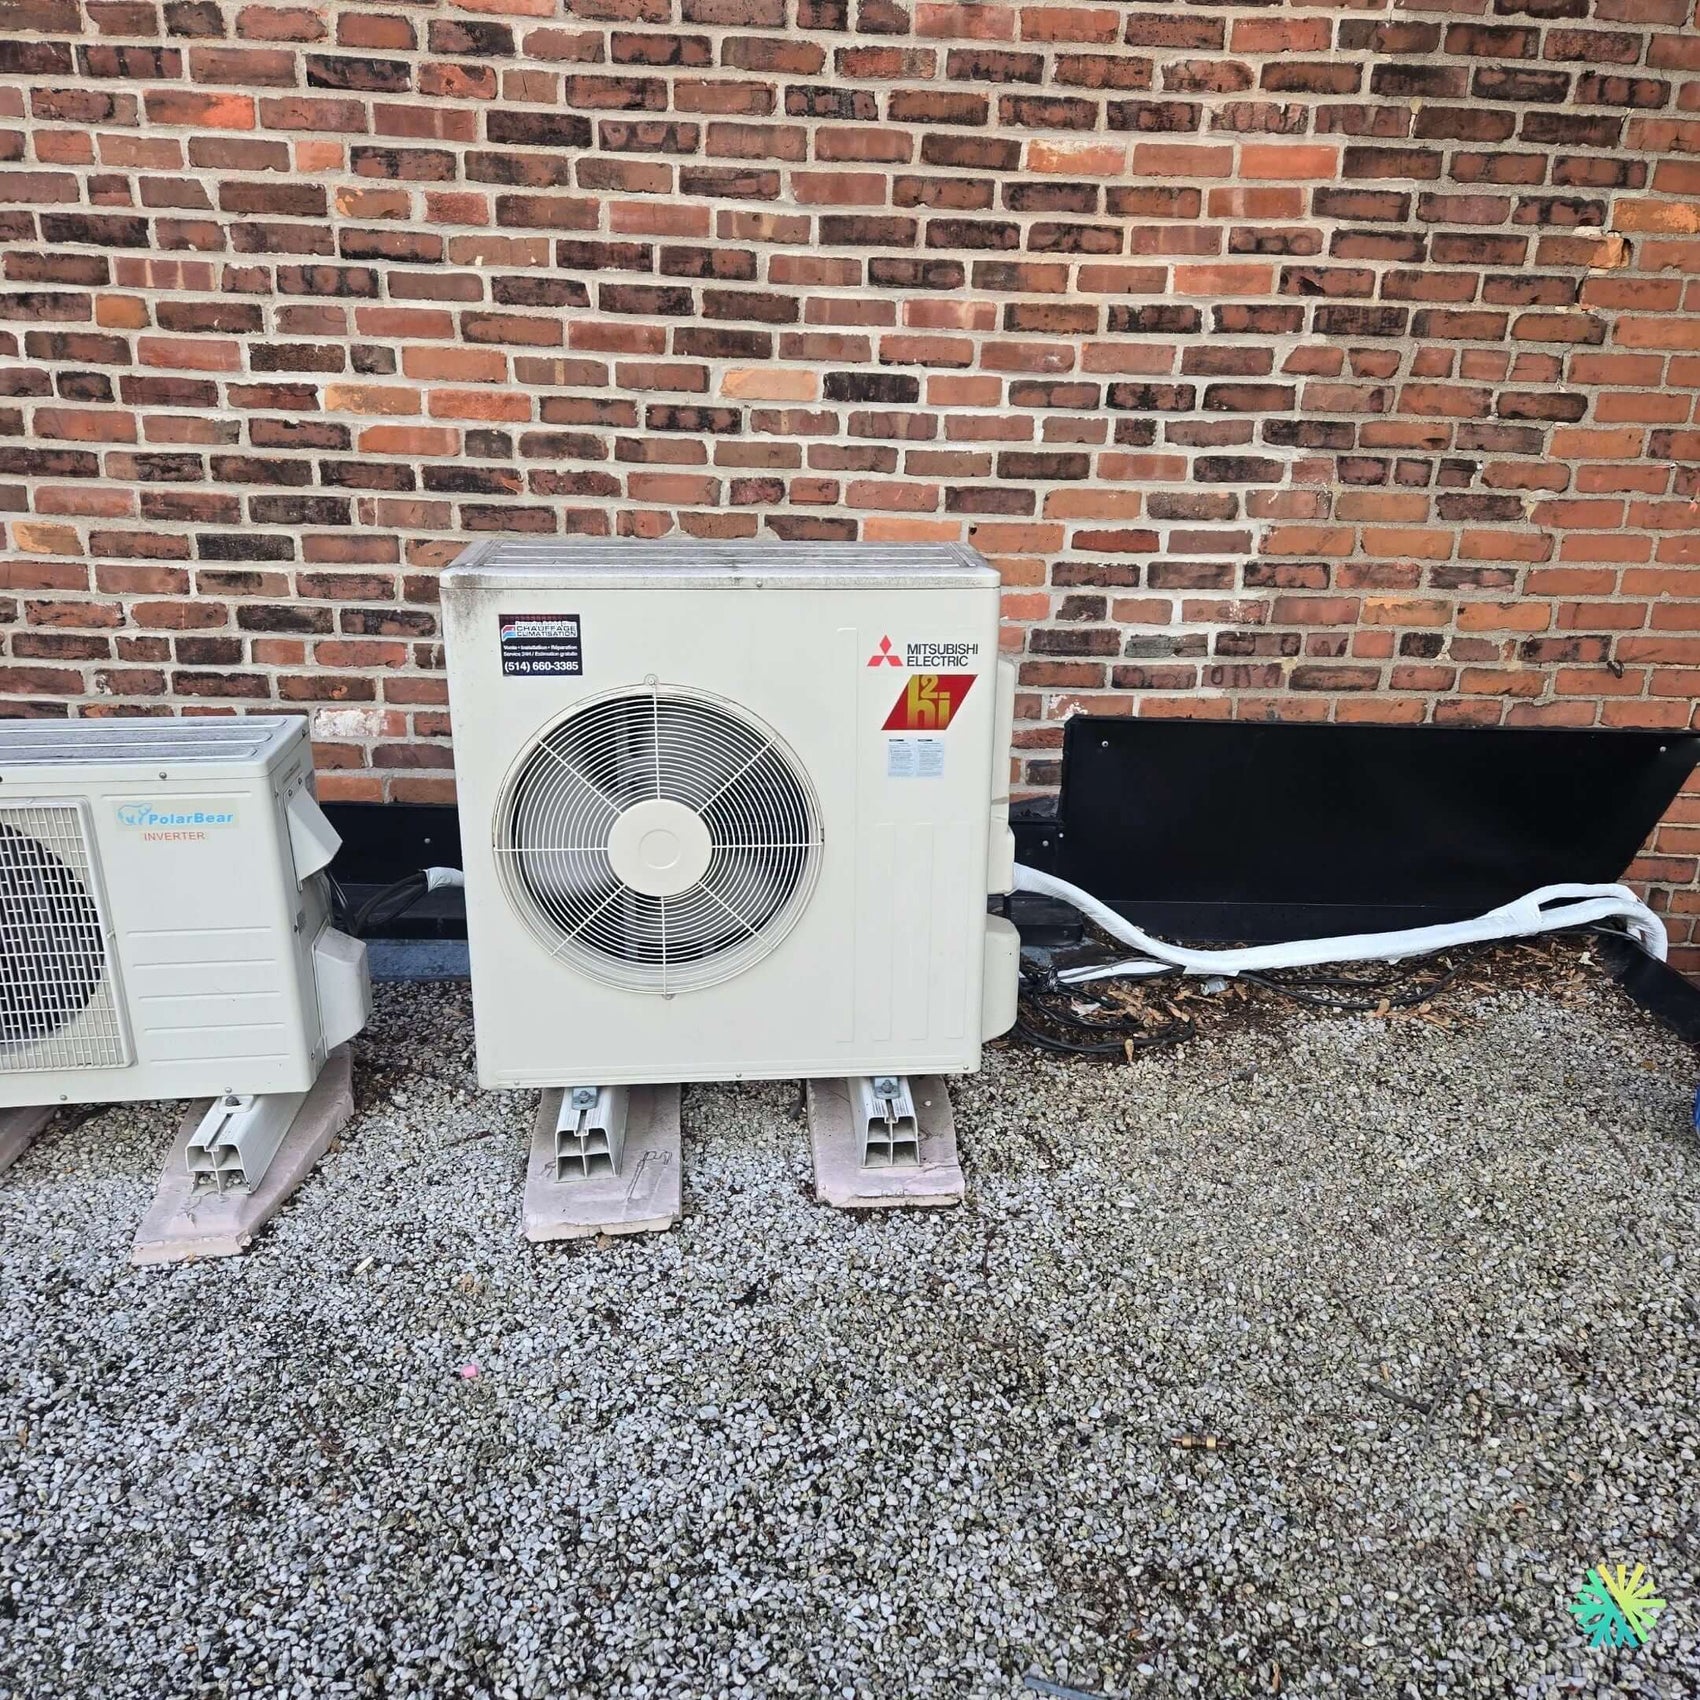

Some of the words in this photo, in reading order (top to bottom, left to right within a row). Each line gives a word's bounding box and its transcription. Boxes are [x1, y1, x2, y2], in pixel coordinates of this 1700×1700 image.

[906, 643, 979, 655] MITSUBISHI
[504, 661, 531, 673] (514)
[532, 661, 579, 671] 660-3385
[906, 655, 969, 667] ELECTRIC
[148, 812, 234, 825] PolarBear
[144, 831, 206, 841] INVERTER
